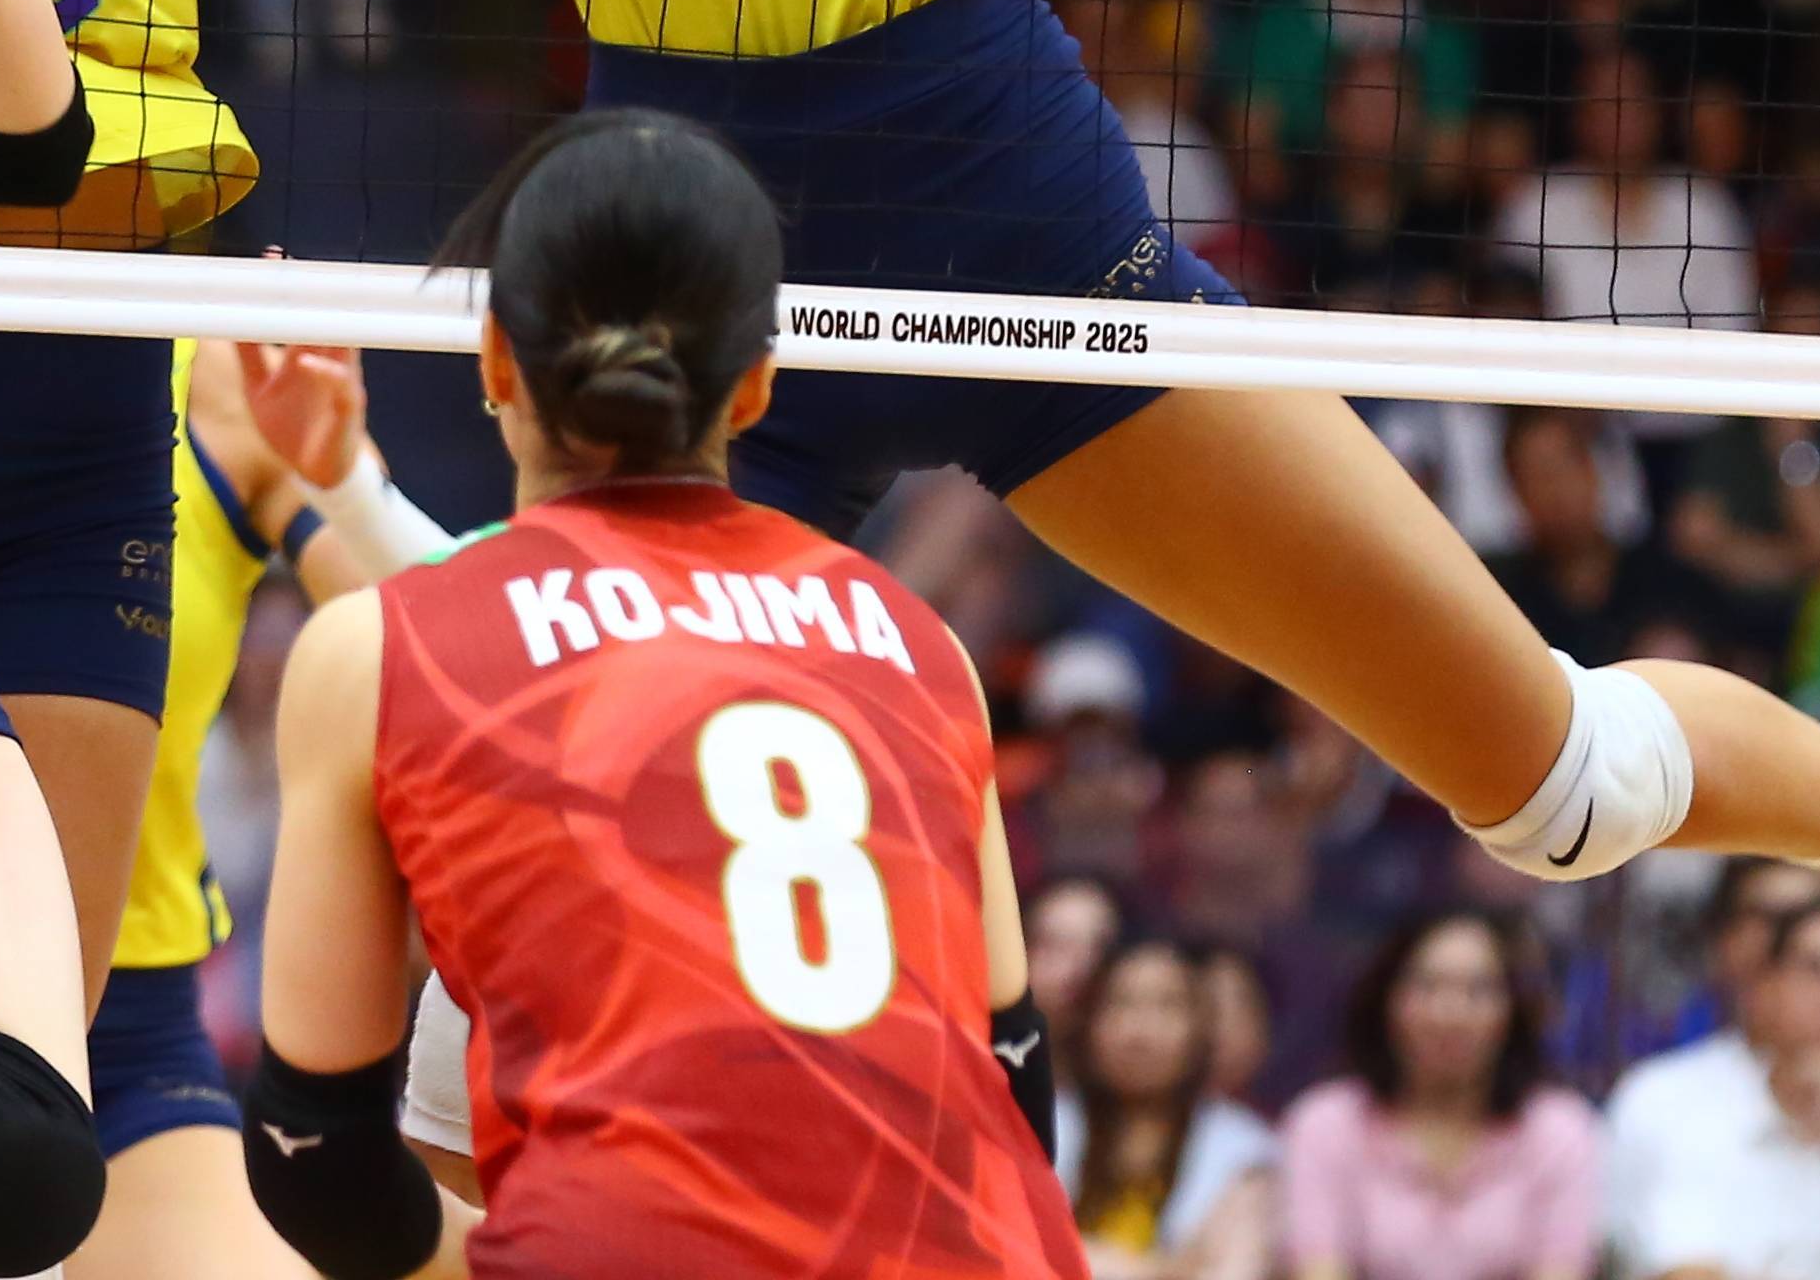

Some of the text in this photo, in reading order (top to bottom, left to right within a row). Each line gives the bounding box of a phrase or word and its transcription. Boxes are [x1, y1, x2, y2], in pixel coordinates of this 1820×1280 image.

[791, 307, 1149, 354] WORLD CHAMPIONSHIP 2025
[505, 567, 917, 675] KOJIMA
[695, 701, 897, 1035] 8
